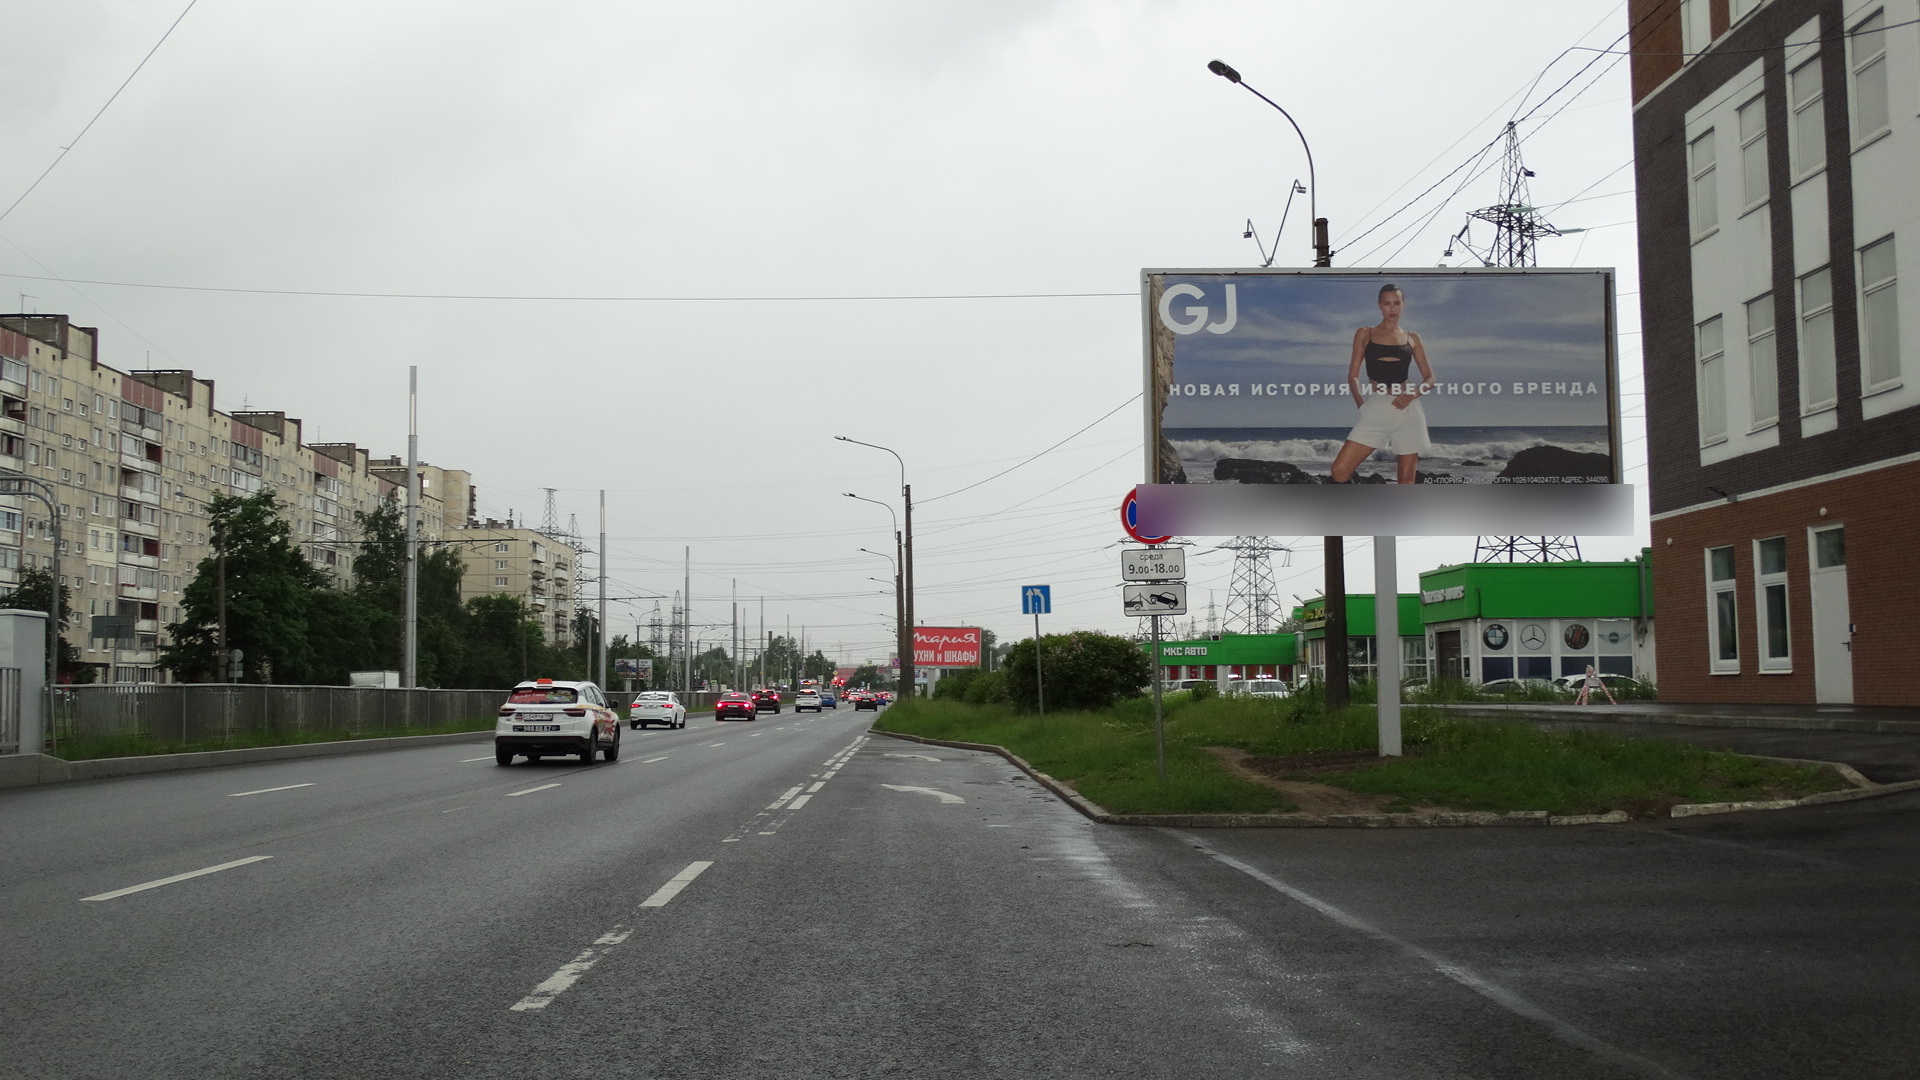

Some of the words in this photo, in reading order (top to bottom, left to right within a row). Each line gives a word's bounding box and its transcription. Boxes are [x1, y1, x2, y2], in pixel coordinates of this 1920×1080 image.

[1159, 283, 1237, 335] GJ
[1170, 383, 1241, 397] НОВАЯ
[1251, 383, 1350, 397] ИСТОРИЯ
[1361, 382, 1502, 396] ИЗВЕСТНОГО
[1513, 382, 1598, 397] БРЕНДА
[1139, 553, 1164, 562] среда
[1128, 563, 1180, 575] 9.00-18.00
[914, 650, 934, 662] УХНИ
[944, 650, 977, 663] ШКАФЫ
[1163, 647, 1182, 656] МКС
[1184, 647, 1207, 656] АВТО
